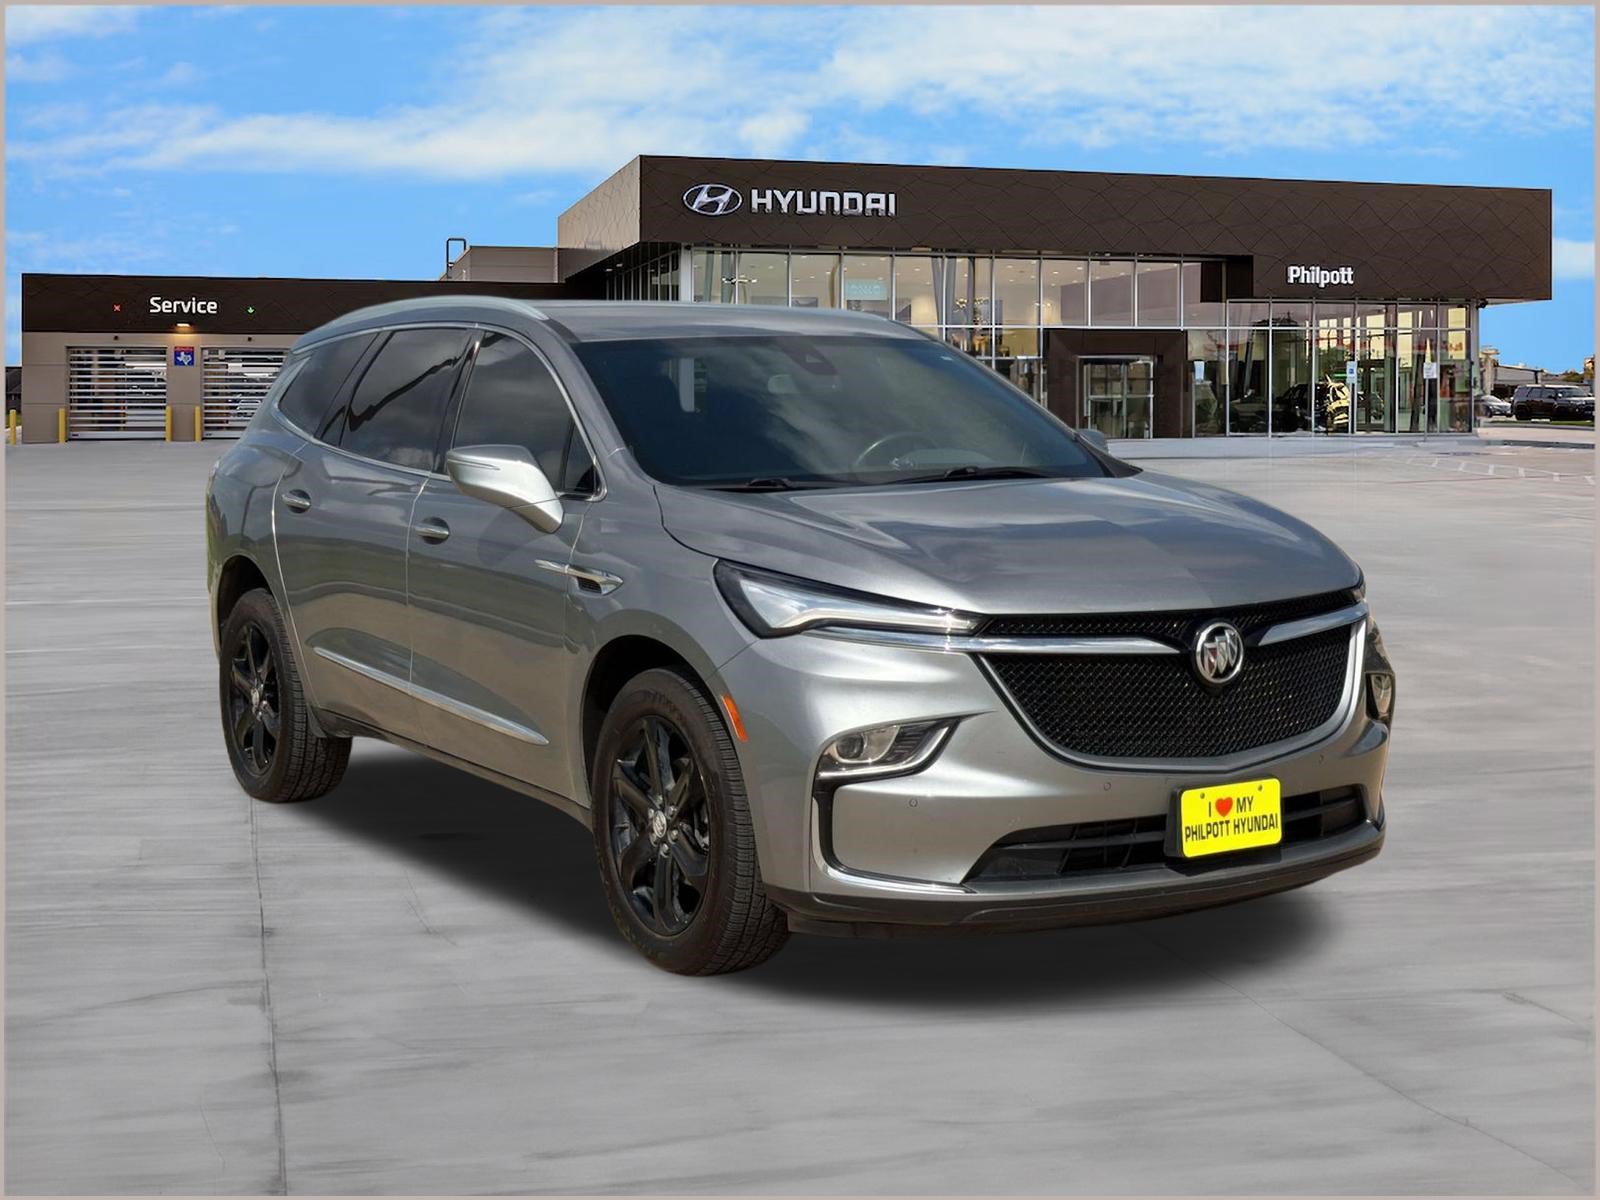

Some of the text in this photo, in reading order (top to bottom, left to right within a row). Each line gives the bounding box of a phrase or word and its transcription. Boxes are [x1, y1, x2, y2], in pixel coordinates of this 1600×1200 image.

[751, 189, 896, 217] HYUNDAI
[1287, 265, 1354, 288] Philpott
[149, 296, 218, 314] Service
[1236, 795, 1254, 814] MY
[1184, 813, 1279, 843] PHILPOTT HYUNDAI
